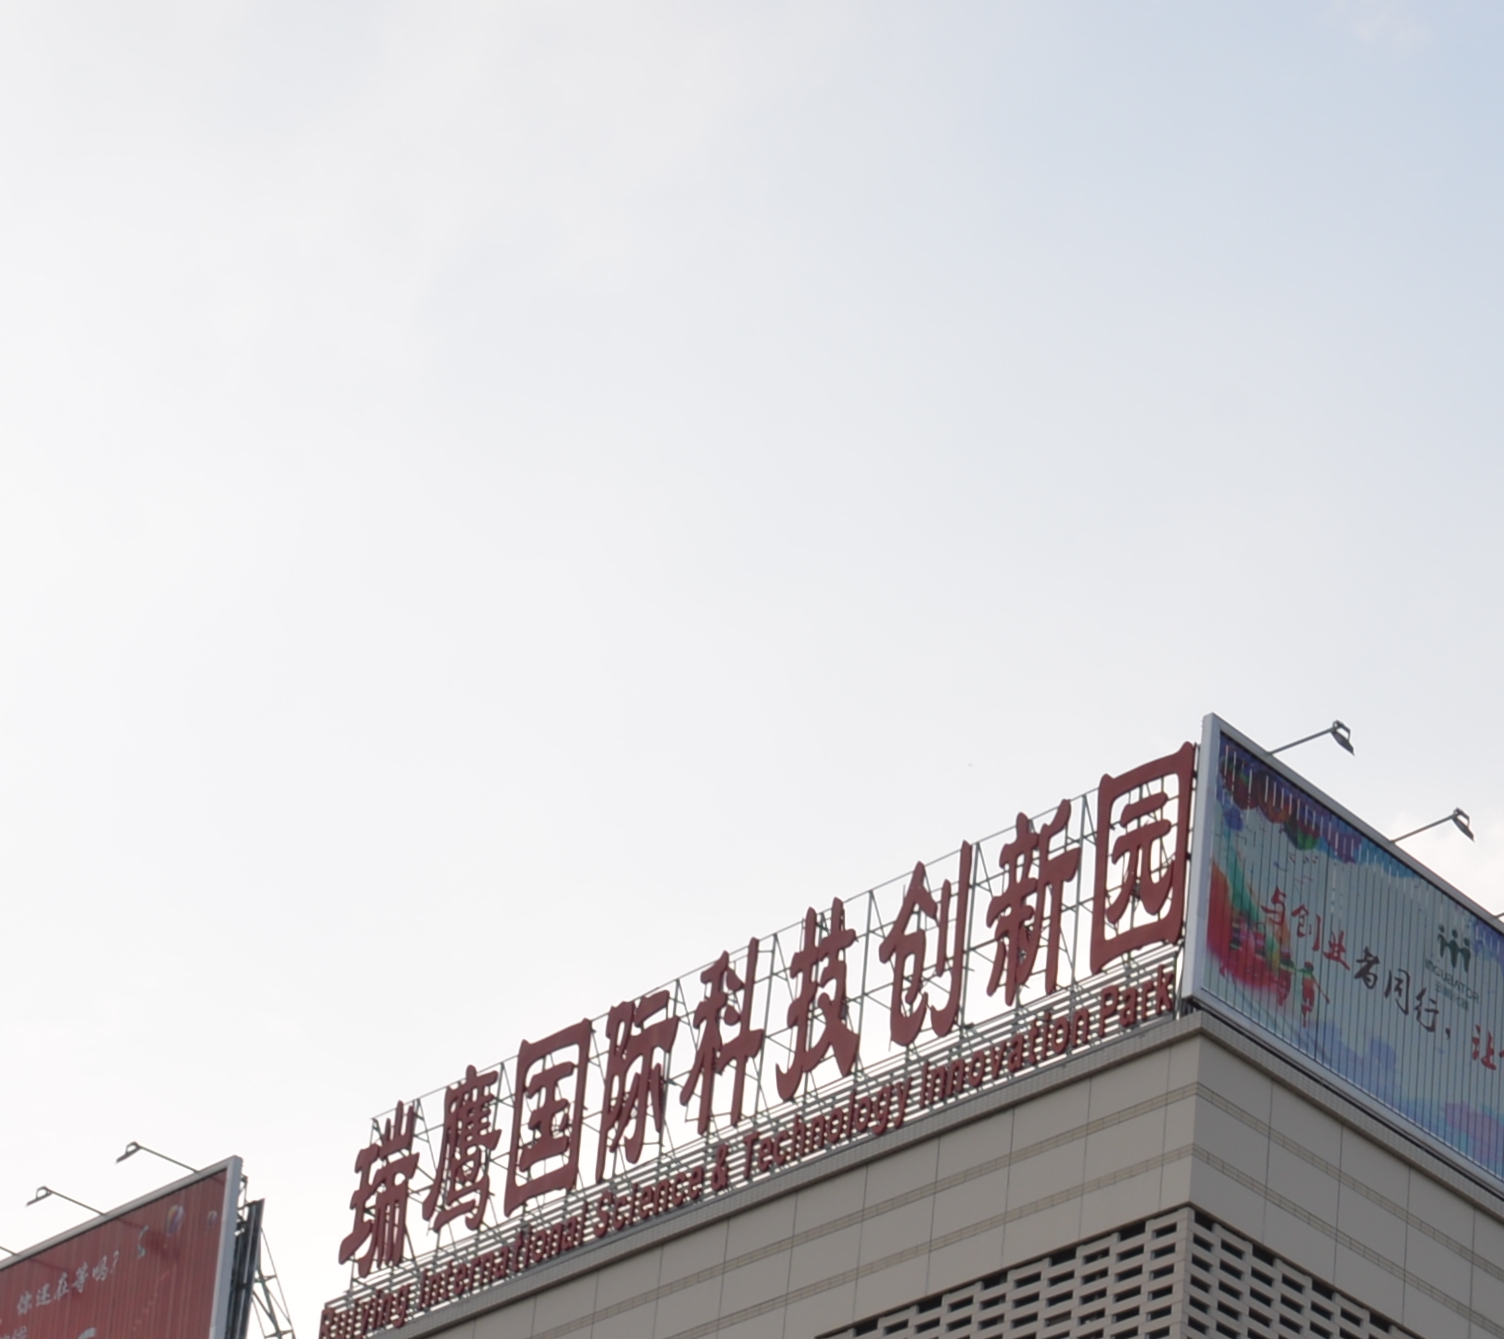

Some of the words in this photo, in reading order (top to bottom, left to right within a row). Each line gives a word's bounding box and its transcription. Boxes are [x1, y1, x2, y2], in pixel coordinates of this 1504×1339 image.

[338, 740, 1195, 1277] 瑞鹰国际科技创新园
[418, 1200, 589, 1310] International
[595, 1165, 704, 1237] Science
[710, 1143, 729, 1190] &
[743, 1076, 910, 1176] Technology
[920, 1008, 1090, 1108] Innovation
[1098, 963, 1175, 1037] Park
